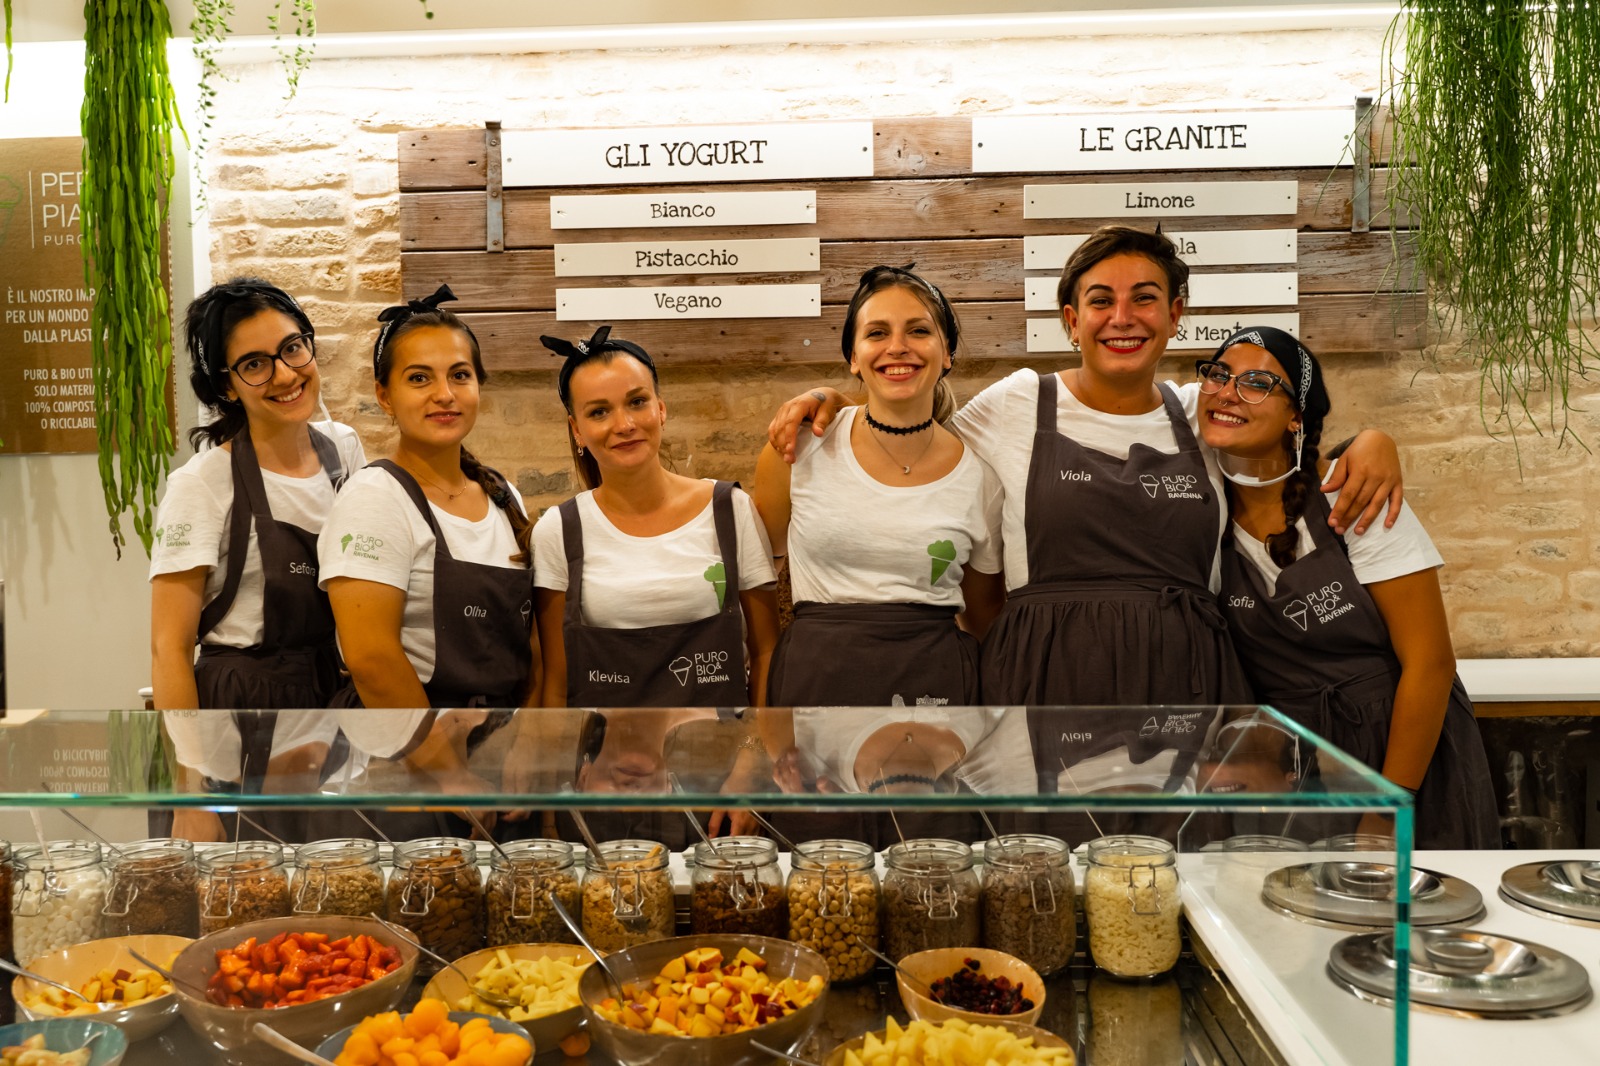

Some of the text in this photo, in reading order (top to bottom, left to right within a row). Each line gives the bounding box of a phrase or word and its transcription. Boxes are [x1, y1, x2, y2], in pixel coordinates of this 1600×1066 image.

[1079, 124, 1248, 152] LE GRANITE
[605, 140, 768, 169] GLI YOGURT
[1125, 192, 1196, 209] Limone
[650, 202, 716, 219] Bianco
[635, 249, 739, 268] Pistacchio
[8, 286, 14, 303] È
[17, 290, 27, 303] IL
[30, 289, 73, 303] NOSTRO
[654, 292, 722, 313] Vegano
[6, 310, 26, 323] PER
[29, 309, 44, 323] UN
[48, 308, 89, 323] MONDO
[24, 329, 58, 343] DALLA
[1176, 324, 1188, 341] &
[24, 368, 49, 380] PURO
[51, 368, 58, 380] &
[60, 368, 76, 380] BIO
[34, 385, 57, 397] SOLO
[25, 401, 51, 413] 100%
[41, 418, 48, 430] O
[1060, 470, 1092, 482] Viola
[1161, 474, 1197, 484] PURO
[1168, 492, 1203, 500] RAVENNA
[167, 523, 192, 533] PURO
[356, 534, 384, 548] PURO
[353, 551, 380, 561] RAVENNA
[1306, 581, 1343, 605] PURO
[1228, 595, 1255, 609] Sofia
[463, 605, 487, 618] Olha
[1319, 602, 1355, 624] RAVENNA
[694, 650, 728, 664] PURO
[588, 670, 630, 684] Klevisa
[697, 674, 730, 684] RAVENNA
